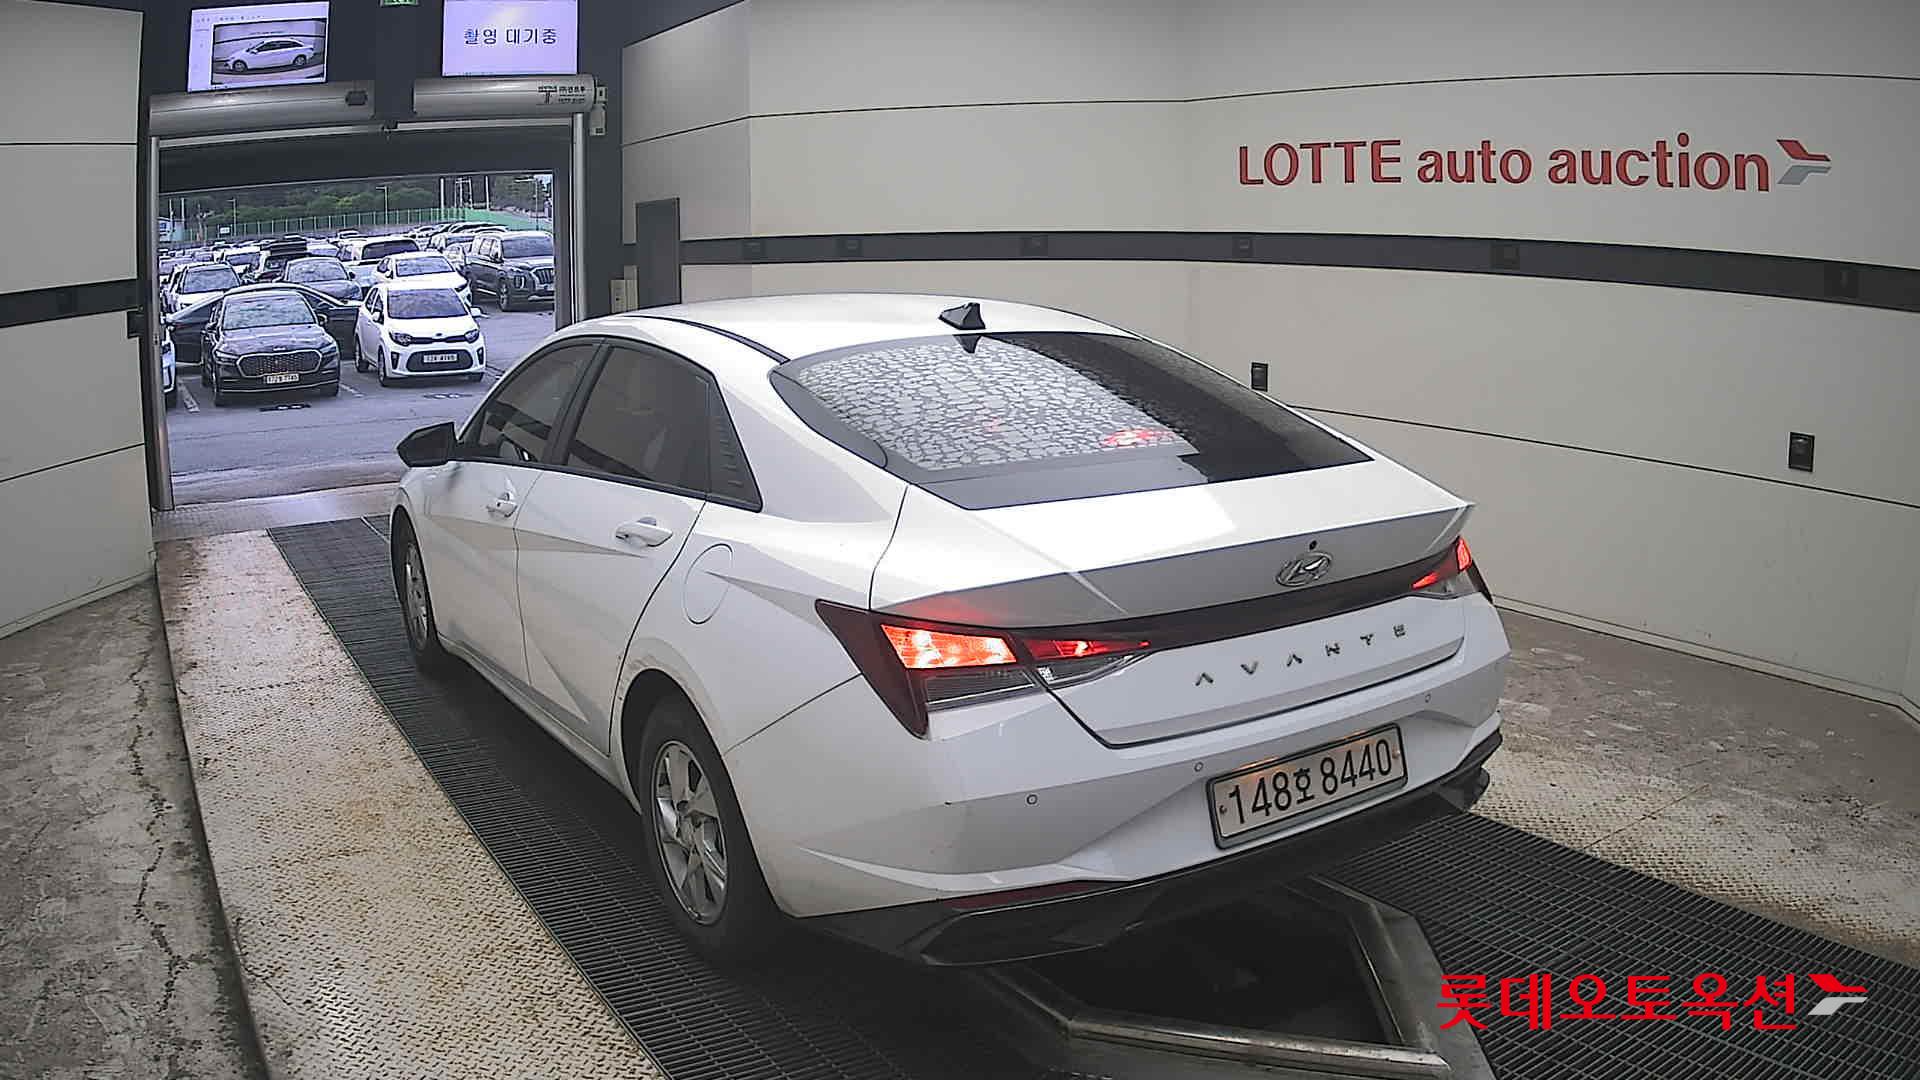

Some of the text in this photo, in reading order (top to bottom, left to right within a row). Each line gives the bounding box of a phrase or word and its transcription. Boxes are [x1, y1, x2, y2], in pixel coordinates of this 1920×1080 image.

[463, 27, 557, 45] 촬영 대기중
[1239, 132, 1770, 192] LOTTE auto auction
[1194, 623, 1406, 687] AVANTE
[1229, 739, 1392, 825] 148호 8440
